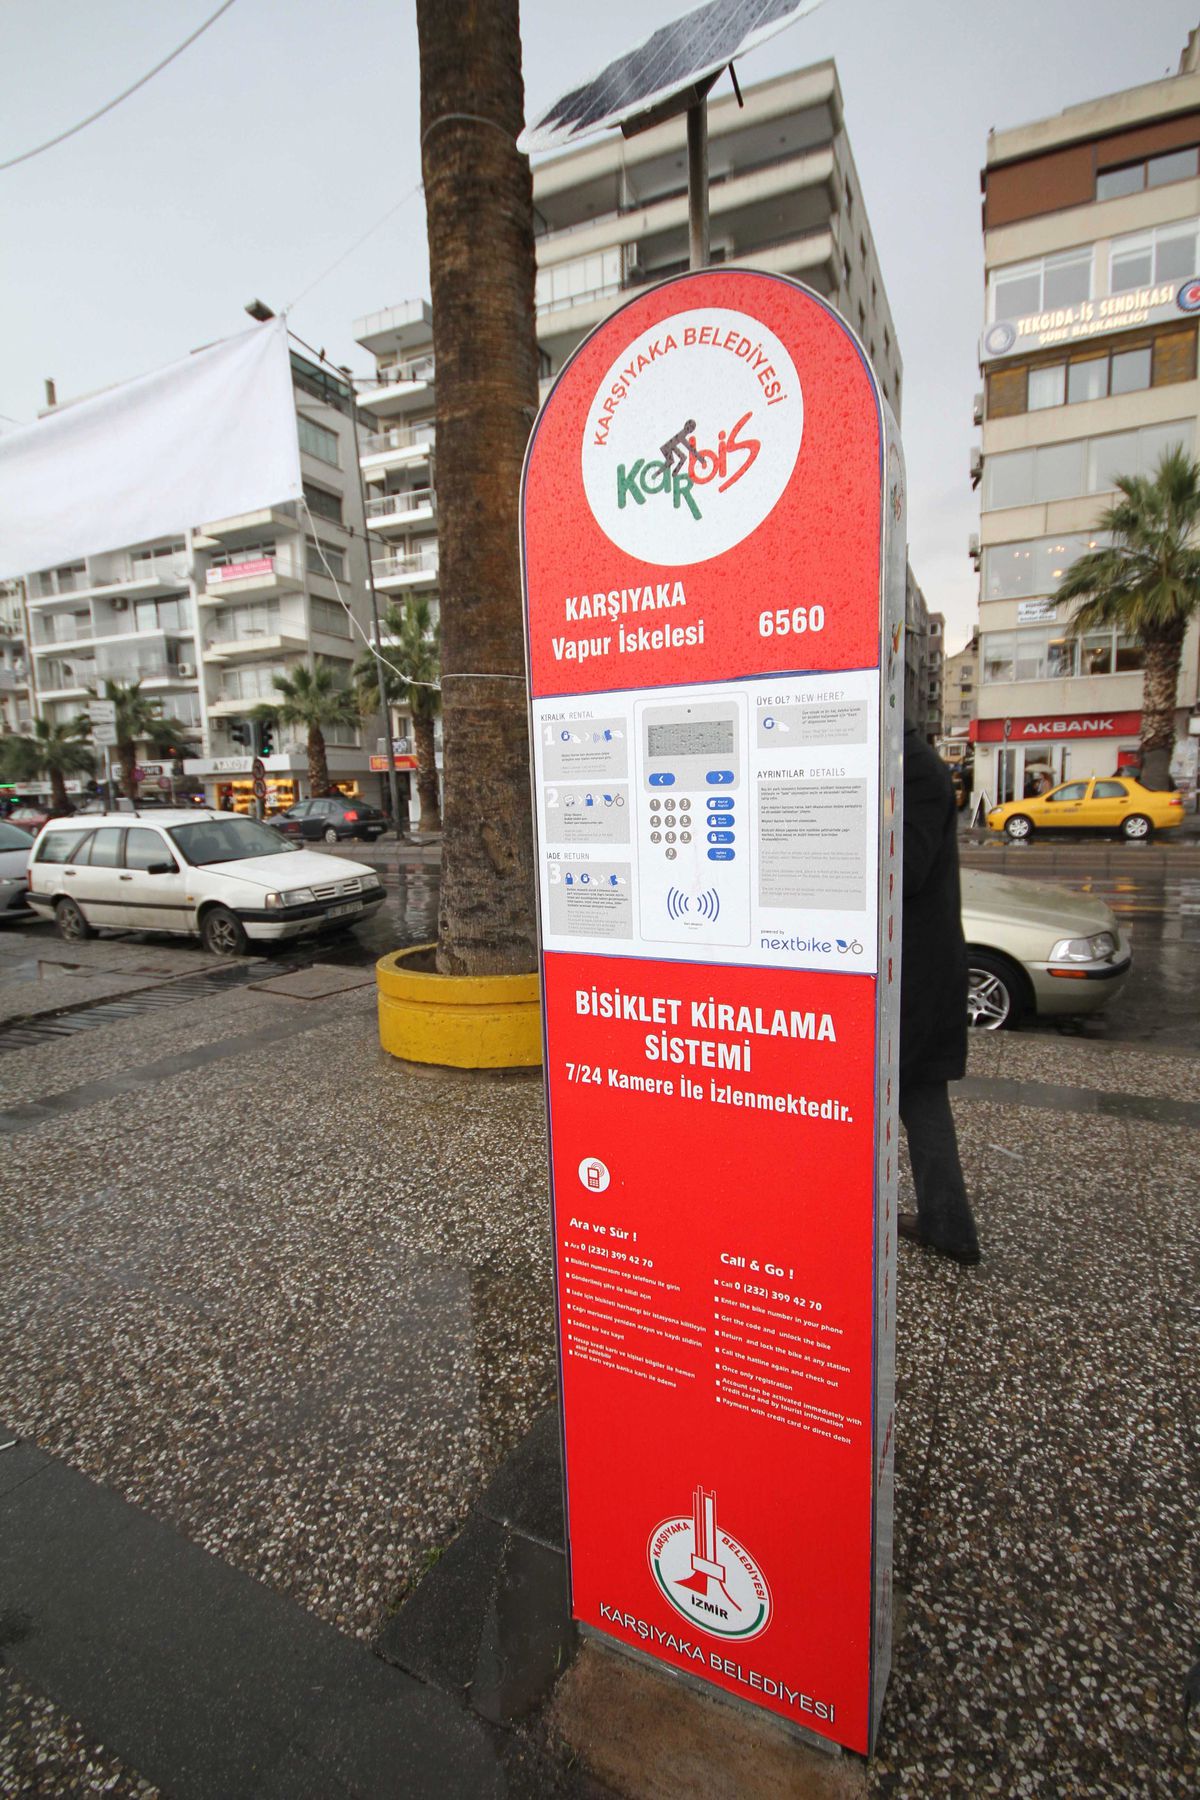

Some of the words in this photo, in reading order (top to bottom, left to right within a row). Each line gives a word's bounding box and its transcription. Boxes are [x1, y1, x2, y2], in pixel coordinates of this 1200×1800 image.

[1099, 284, 1175, 318] SENDİKASI
[594, 335, 678, 446] KARŞIYAKA
[684, 326, 788, 406] BELEDİYESİ
[565, 581, 687, 625] KARŞIYAKA
[758, 605, 825, 637] 6560
[552, 636, 611, 663] Vapur
[618, 620, 705, 653] İskelesi
[775, 695, 790, 704] OL?
[795, 694, 815, 703] NEW
[817, 691, 845, 701] HERE?
[569, 711, 594, 719] RENTAL
[1023, 719, 1115, 734] AKBANK
[544, 725, 555, 746] 1
[757, 769, 804, 779] AYRINTILAR
[810, 768, 846, 777] DETAILS
[547, 788, 559, 808] 2
[564, 852, 590, 860] RETURN
[549, 863, 561, 884] 3
[761, 937, 832, 953] nextbike
[575, 986, 682, 1025] BİSİKLET
[691, 997, 837, 1043] KİRALAMA
[645, 1030, 751, 1072] SİSTEMİ
[565, 1062, 602, 1085] 7/24
[608, 1069, 674, 1095] Kamere
[680, 1074, 703, 1100] İle
[710, 1078, 853, 1123] İzlenmektedir.
[570, 1217, 589, 1230] Ara
[592, 1224, 606, 1234] ve
[609, 1226, 629, 1240] Sür
[633, 1232, 637, 1242] !
[581, 1243, 586, 1251] 0
[588, 1245, 609, 1258] (232)
[611, 1250, 627, 1261] 399
[629, 1255, 640, 1265] 42
[642, 1258, 653, 1268] 70
[720, 1253, 745, 1268] Call
[750, 1260, 760, 1271] &
[764, 1264, 784, 1277] Go
[789, 1269, 794, 1279] !
[721, 1280, 733, 1288] Call
[735, 1282, 741, 1290] 0
[743, 1284, 769, 1299] (232)
[771, 1291, 790, 1302] 399
[793, 1297, 806, 1307] 42
[809, 1300, 822, 1311] 70
[721, 1297, 737, 1306] Enter
[739, 1302, 750, 1310] the
[752, 1305, 766, 1314] bike
[767, 1310, 793, 1321] number
[803, 1320, 819, 1328] your
[821, 1324, 844, 1335] phone
[721, 1315, 732, 1323] Get
[763, 1327, 775, 1335] and
[779, 1332, 802, 1342] unlock
[803, 1337, 815, 1346] the
[816, 1341, 831, 1350] bike
[721, 1331, 743, 1342] Return
[746, 1339, 759, 1347] and
[760, 1342, 774, 1351] lock
[775, 1346, 786, 1354] the
[788, 1350, 803, 1359] bike
[813, 1358, 825, 1367] any
[826, 1362, 851, 1373] station
[721, 1348, 734, 1356] Call
[771, 1363, 789, 1373] again
[791, 1369, 804, 1377] and
[805, 1374, 825, 1383] check
[826, 1380, 839, 1388] out
[721, 1365, 738, 1374] Once
[755, 1375, 793, 1391] registration
[722, 1377, 748, 1390] Account
[772, 1393, 802, 1407] activated
[803, 1403, 845, 1421] immediately
[846, 1417, 862, 1426] with
[722, 1386, 740, 1395] credit
[741, 1392, 756, 1400] card
[757, 1397, 770, 1405] and
[771, 1401, 780, 1409] by
[780, 1404, 802, 1415] tourist
[804, 1411, 844, 1428] information
[722, 1398, 749, 1411] Payment
[750, 1407, 766, 1416] with
[787, 1419, 802, 1428] card
[812, 1427, 832, 1437] direct
[833, 1434, 851, 1444] debit
[653, 1522, 691, 1558] KARŞIYAKA
[721, 1537, 767, 1601] BELEDİYESİ
[692, 1594, 728, 1620] İZMİR
[600, 1602, 706, 1664] KARŞIYAKA
[710, 1653, 834, 1723] BELEDİYESİ
